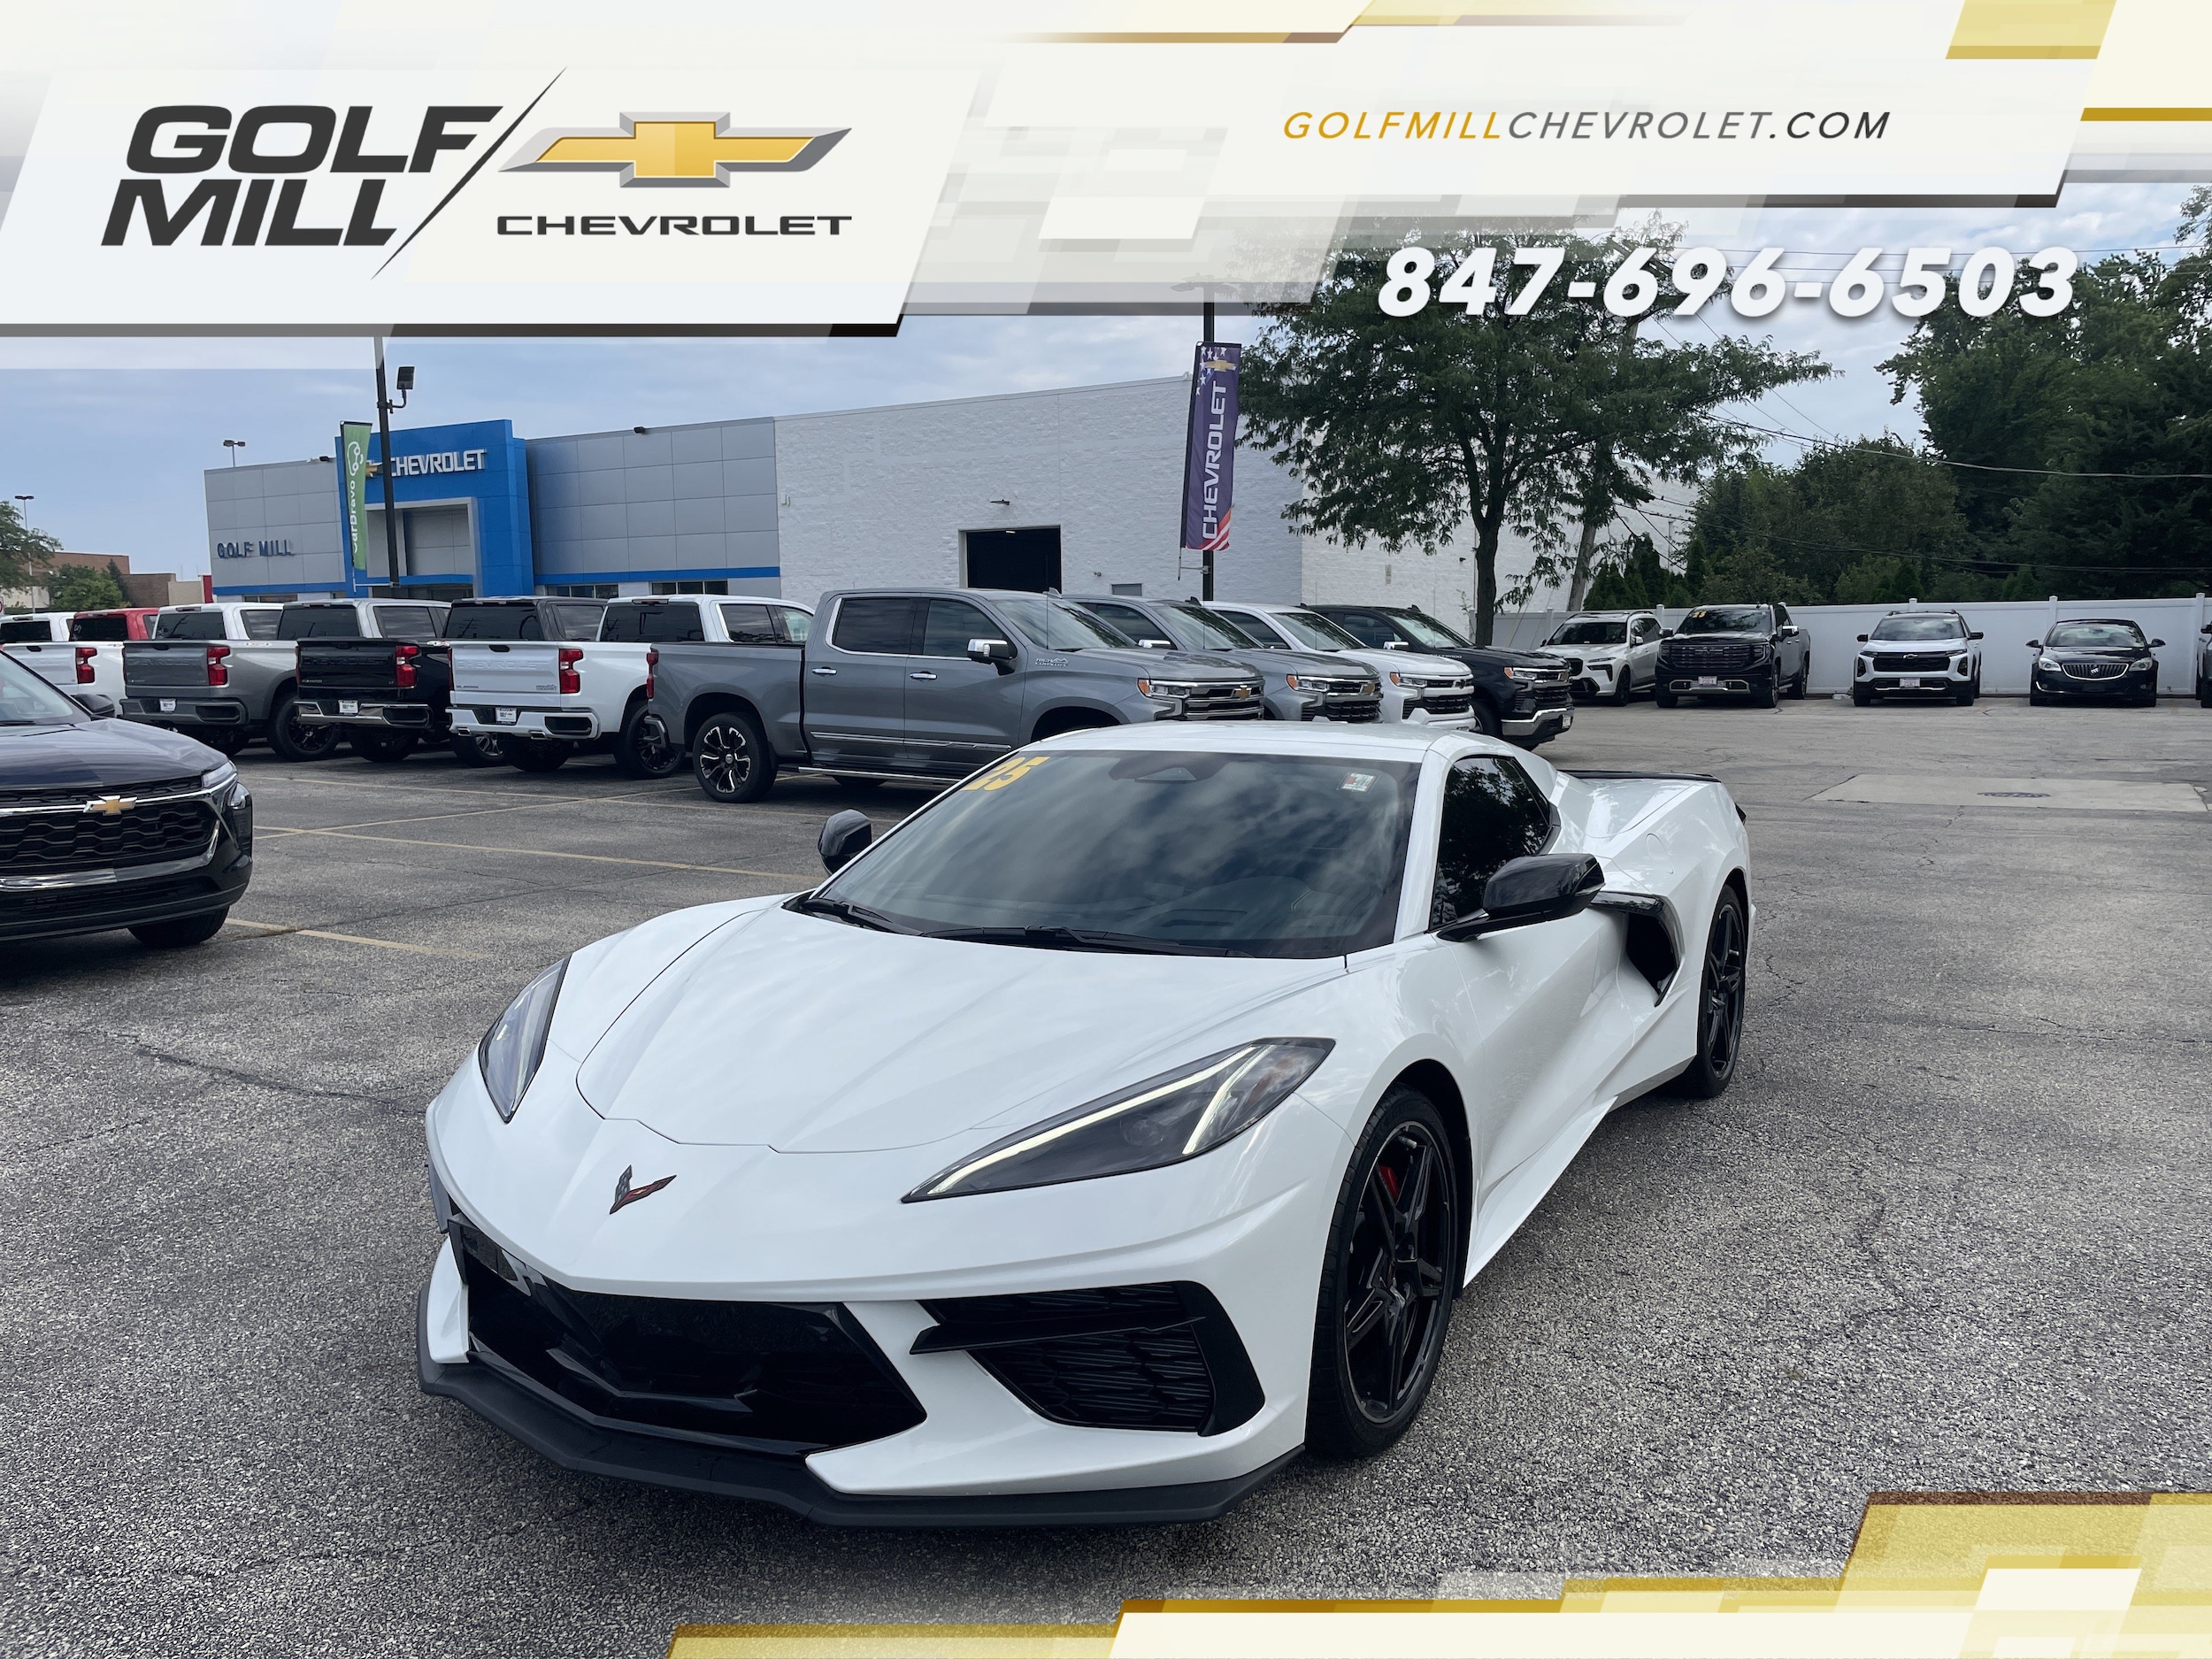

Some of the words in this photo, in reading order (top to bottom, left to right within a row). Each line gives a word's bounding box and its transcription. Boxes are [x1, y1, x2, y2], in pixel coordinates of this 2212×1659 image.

[1202, 380, 1227, 540] CHEVROLET
[217, 541, 254, 559] GOLF
[258, 539, 295, 557] MILL
[959, 757, 1050, 791] 25
